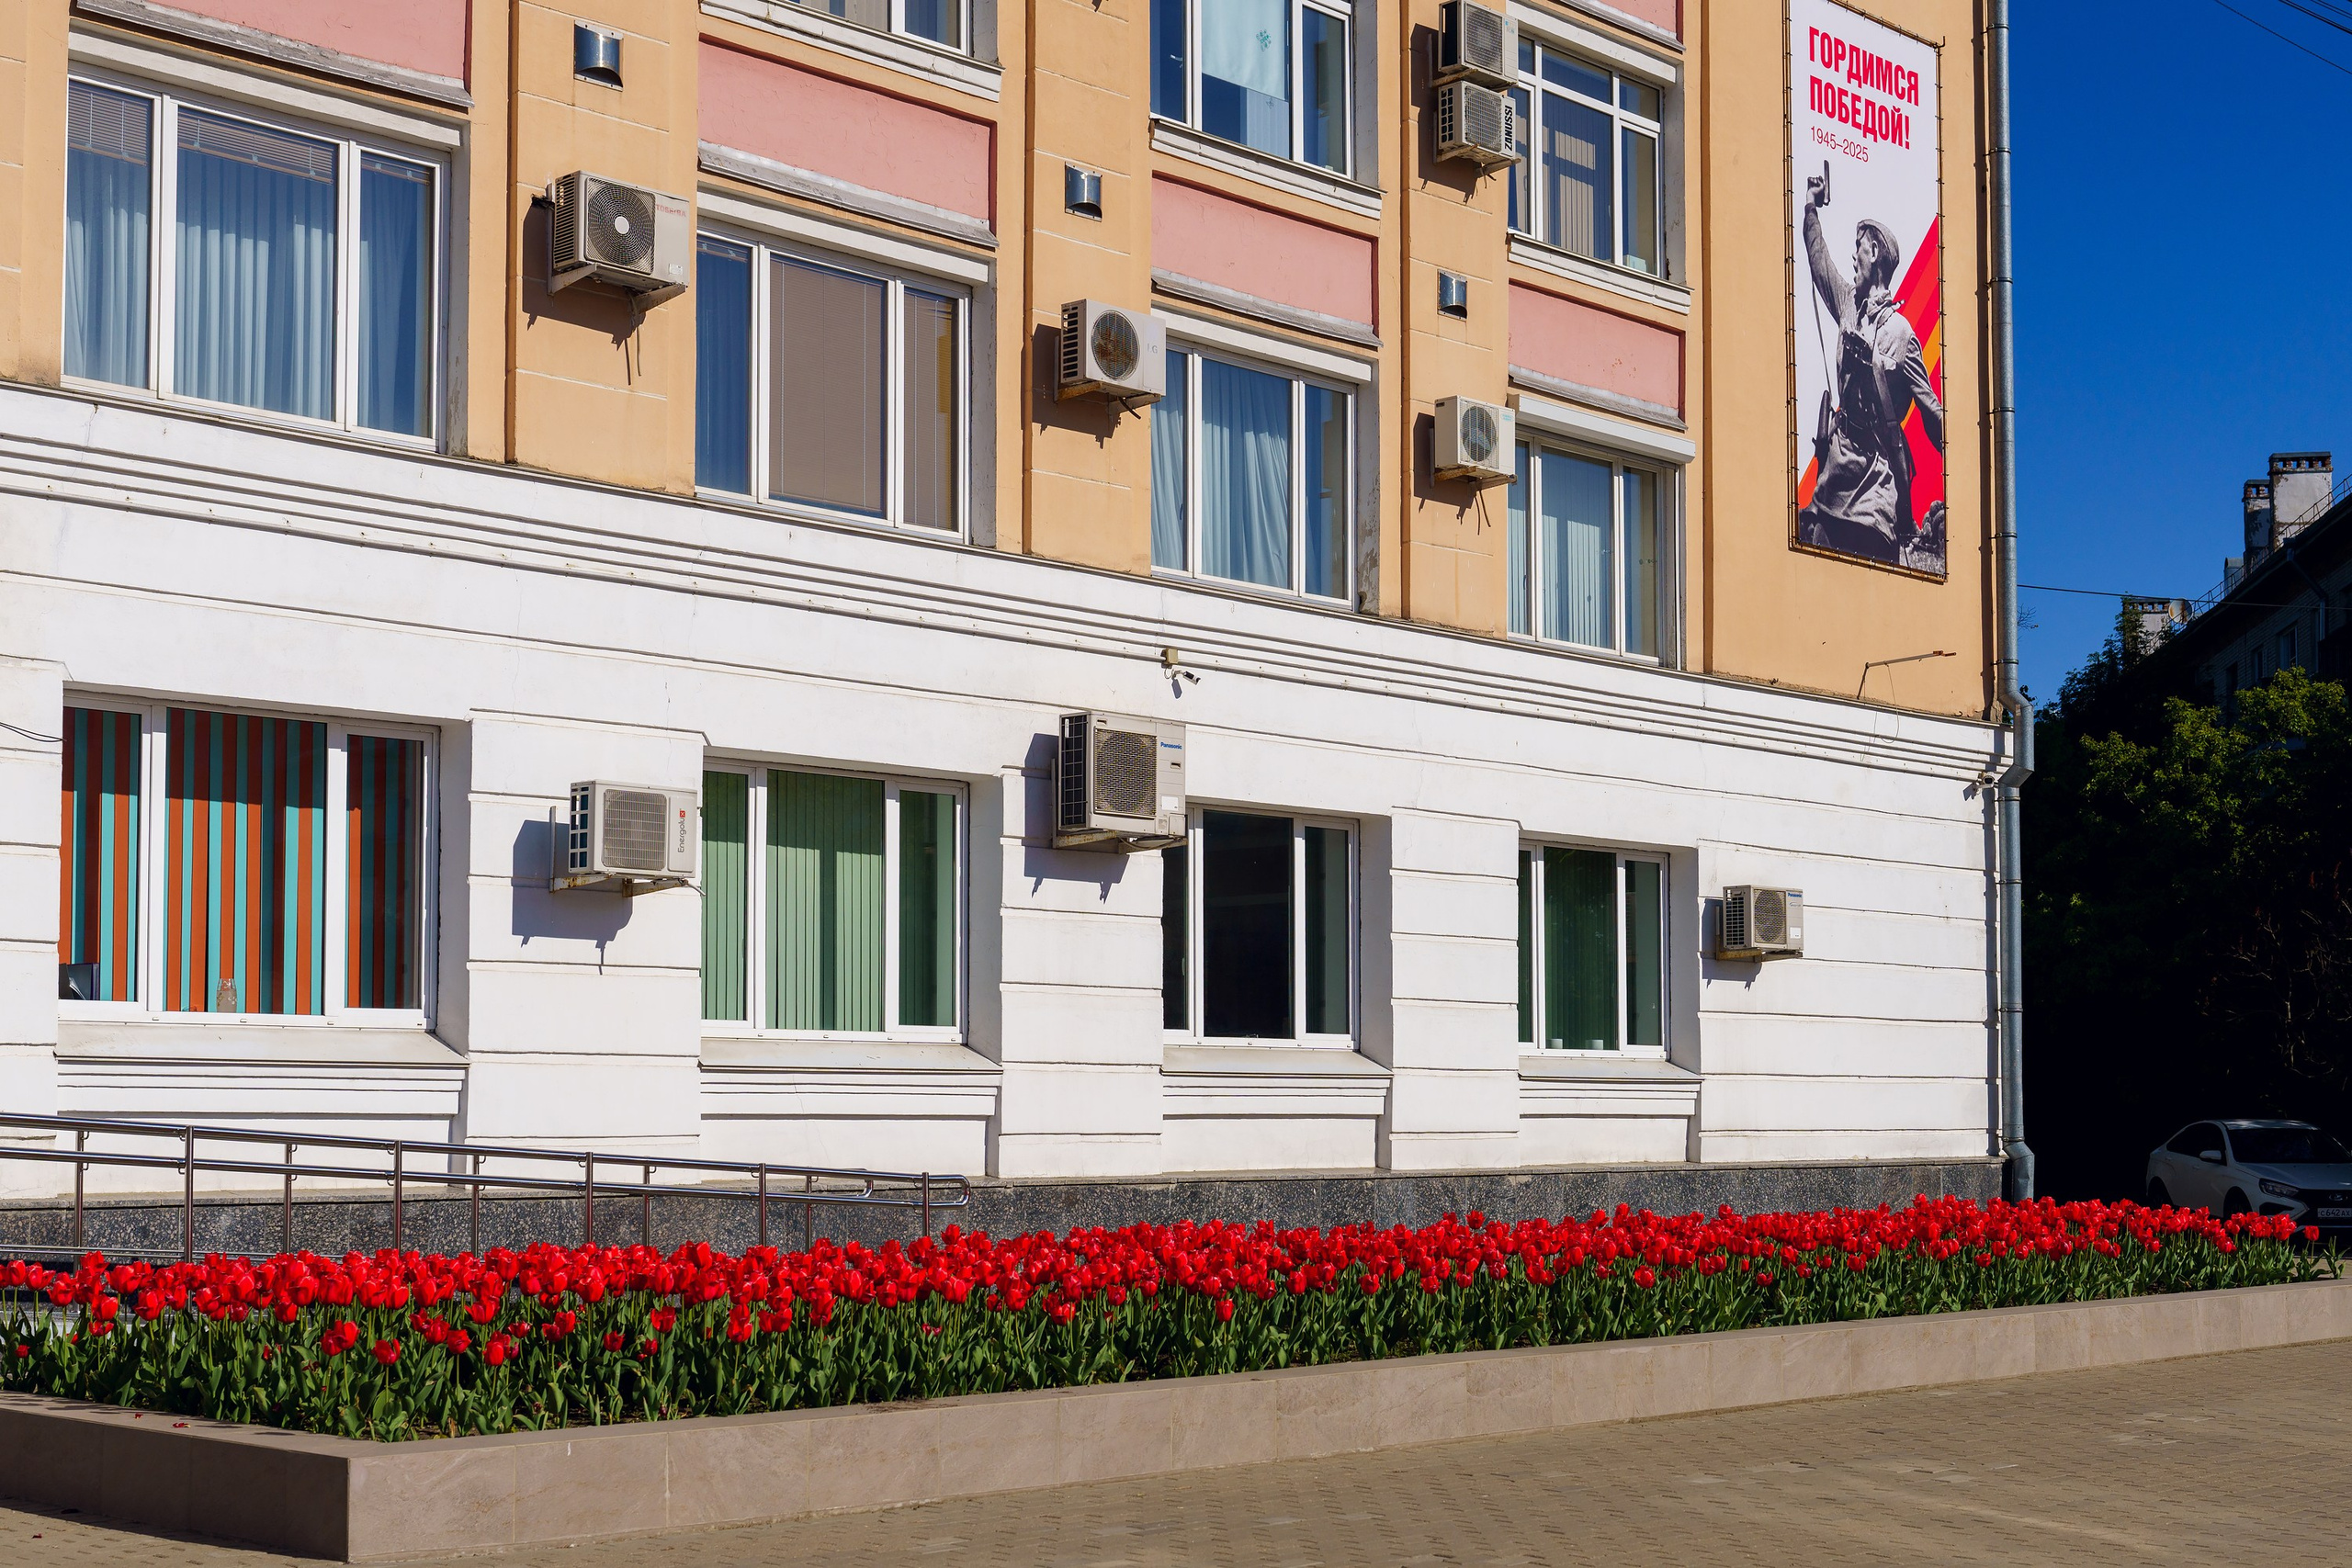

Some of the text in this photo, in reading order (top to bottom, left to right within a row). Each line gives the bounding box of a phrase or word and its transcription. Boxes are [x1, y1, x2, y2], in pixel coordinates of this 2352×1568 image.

[1809, 26, 1919, 107] ГОРДИМСЯ
[1504, 105, 1513, 151] ZANUSSI
[1810, 74, 1910, 150] ПОБЕДОЙ!
[1160, 741, 1182, 750] Panasonic
[678, 809, 687, 854] Energolux
